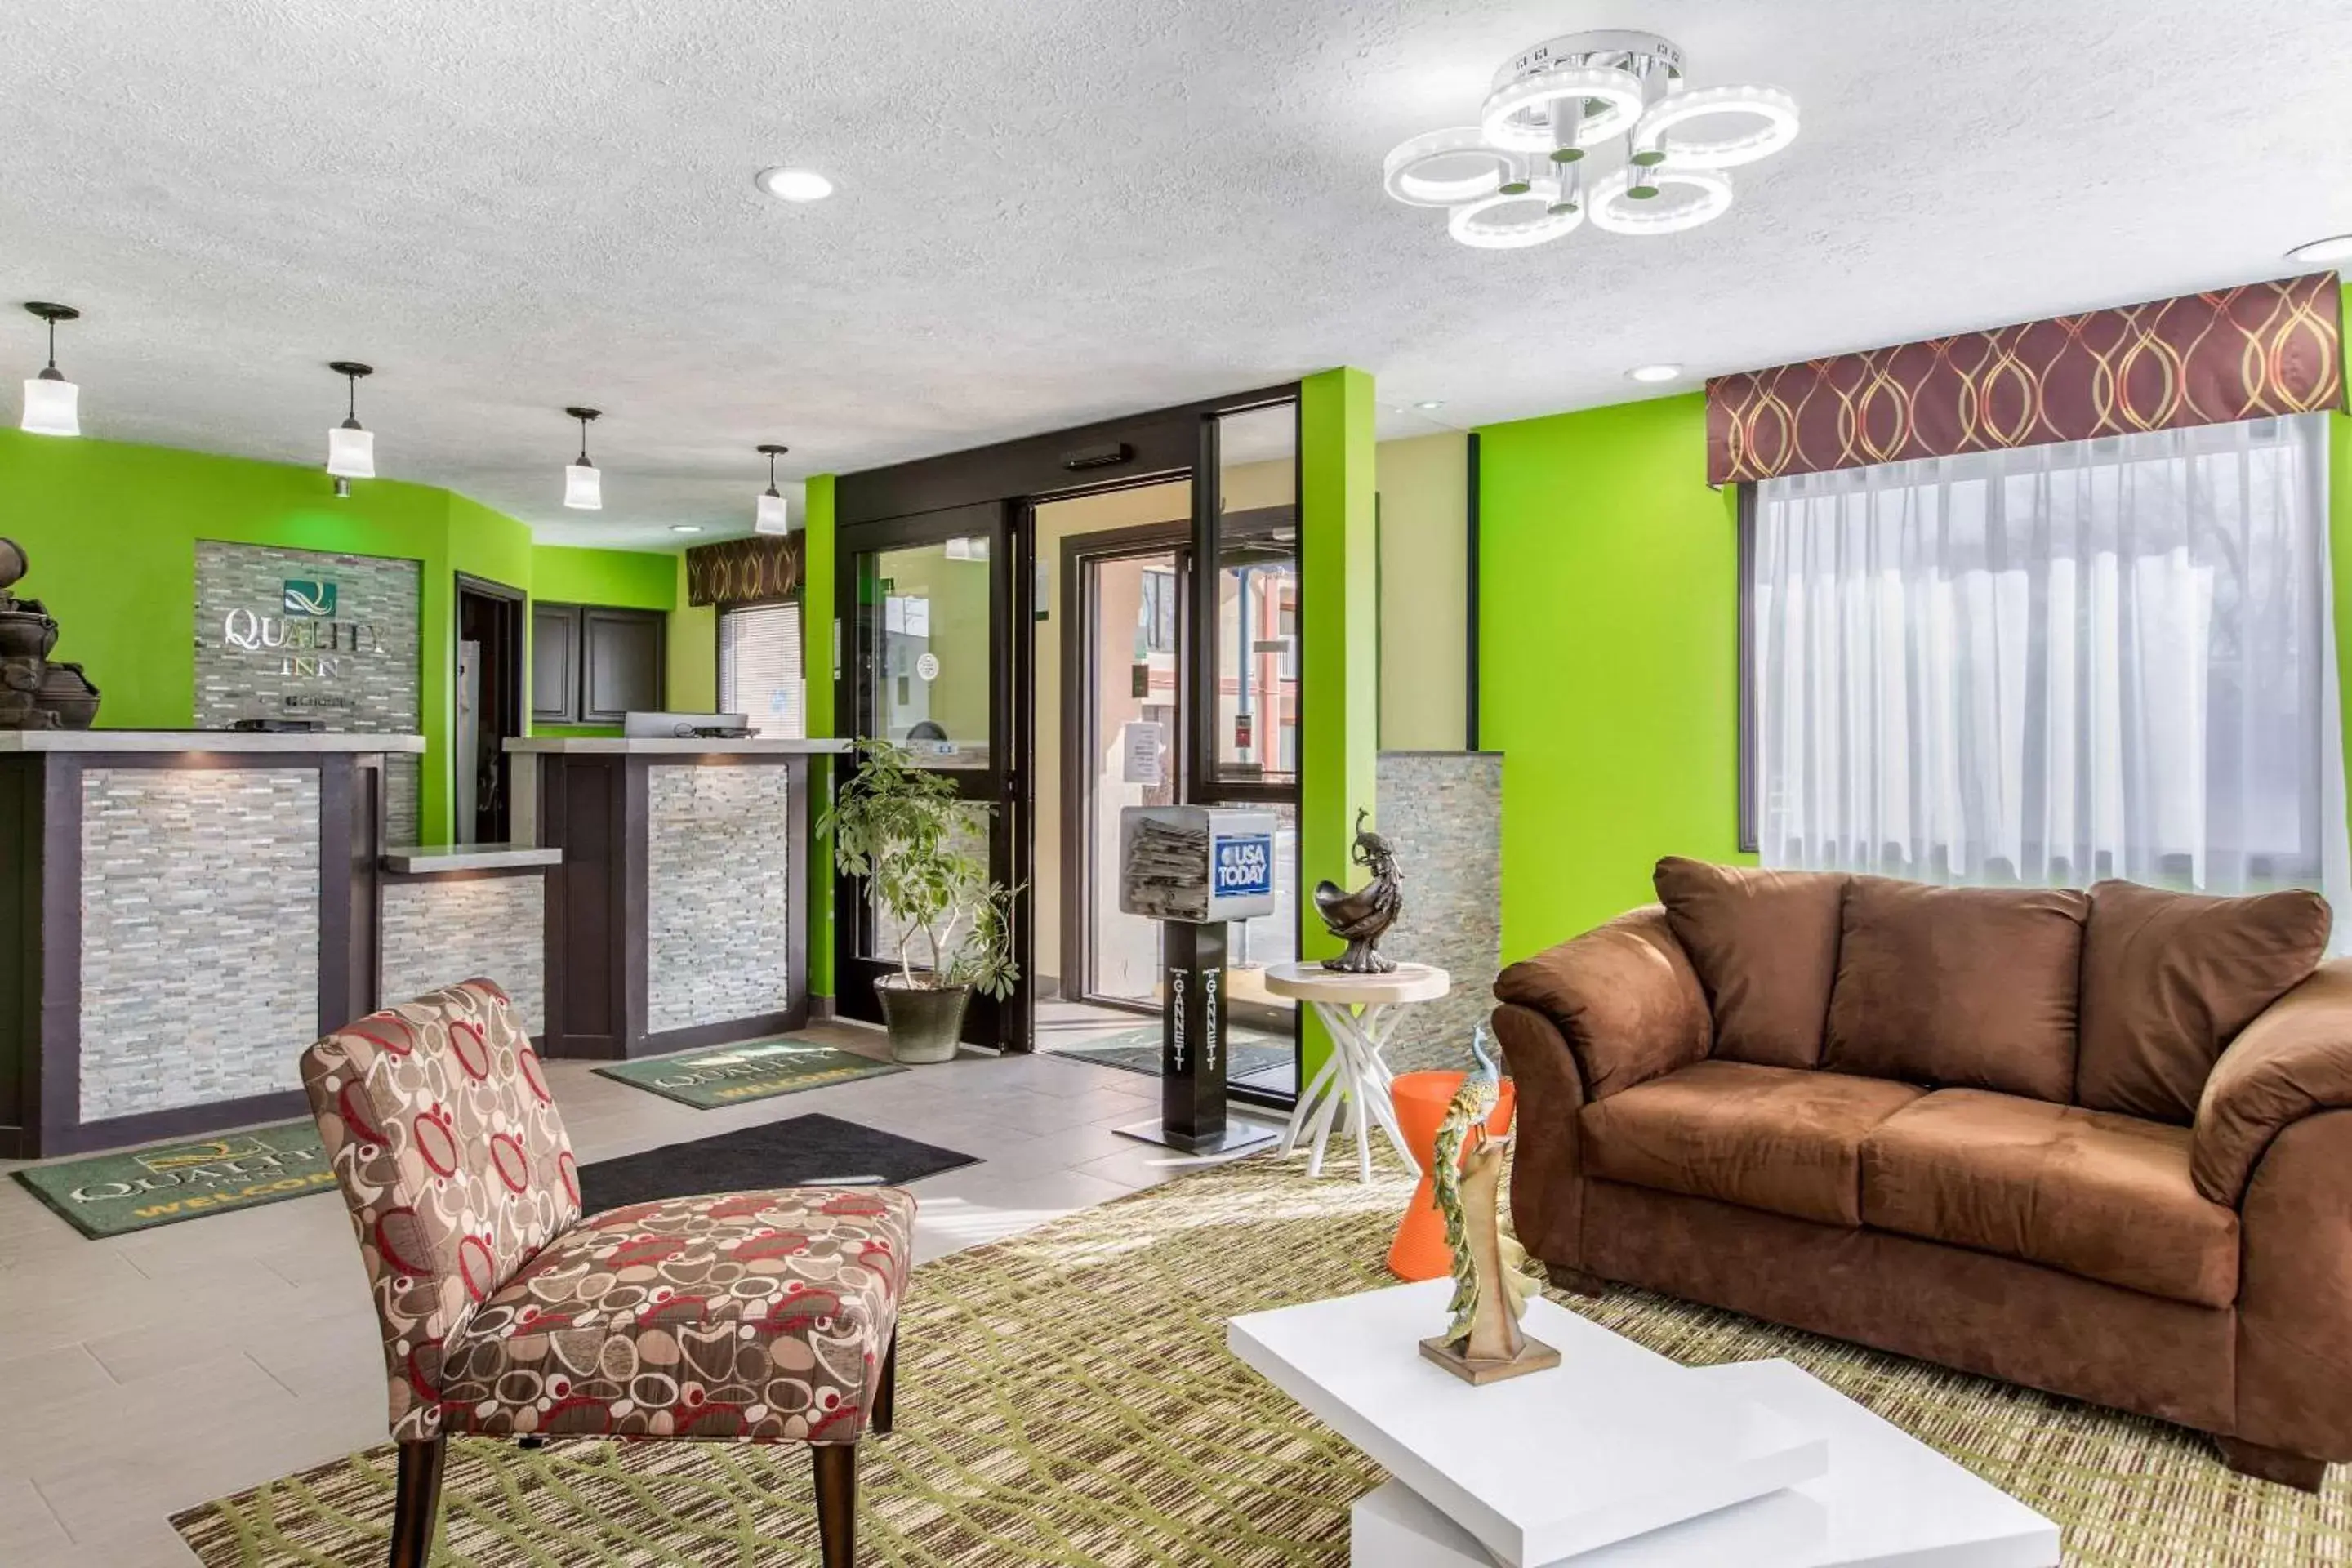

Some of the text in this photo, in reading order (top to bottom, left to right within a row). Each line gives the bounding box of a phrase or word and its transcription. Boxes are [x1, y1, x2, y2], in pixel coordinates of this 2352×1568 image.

[225, 608, 385, 653] QUALITY
[280, 657, 339, 677] INN
[1218, 864, 1267, 887] TODAY
[1235, 844, 1266, 866] USA
[1174, 979, 1184, 1071] GANNETT
[1206, 979, 1217, 1071] GANNETT
[69, 1146, 321, 1204] QUALIT
[133, 1170, 337, 1218] WELCOM
